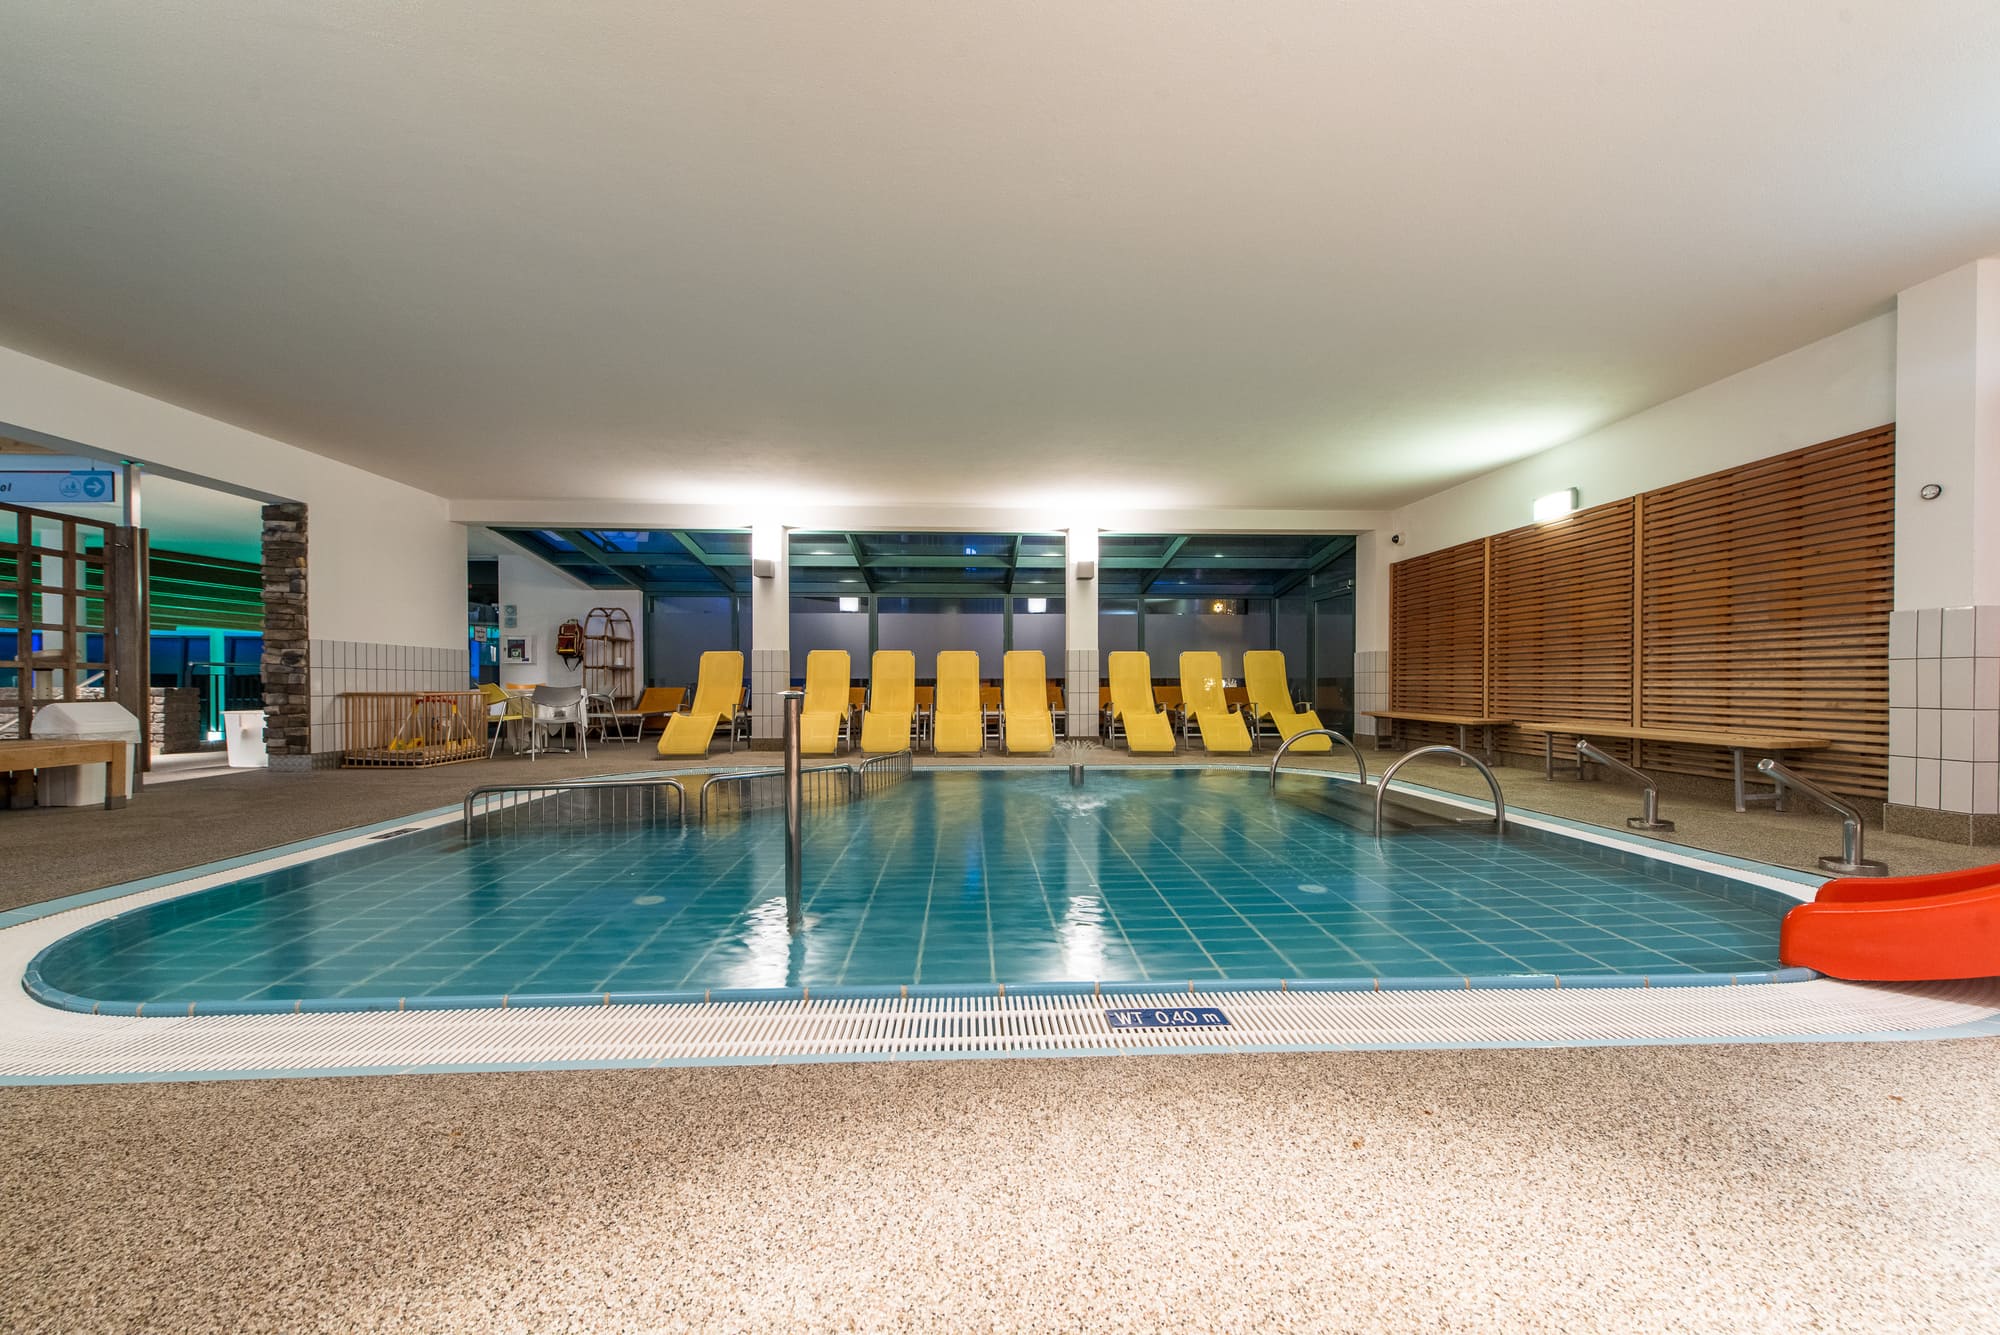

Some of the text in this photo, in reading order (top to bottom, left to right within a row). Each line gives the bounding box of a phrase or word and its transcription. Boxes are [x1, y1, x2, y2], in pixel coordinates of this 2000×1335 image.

[0, 482, 12, 492] ol
[1114, 1010, 1221, 1025] WT 0,40 m
